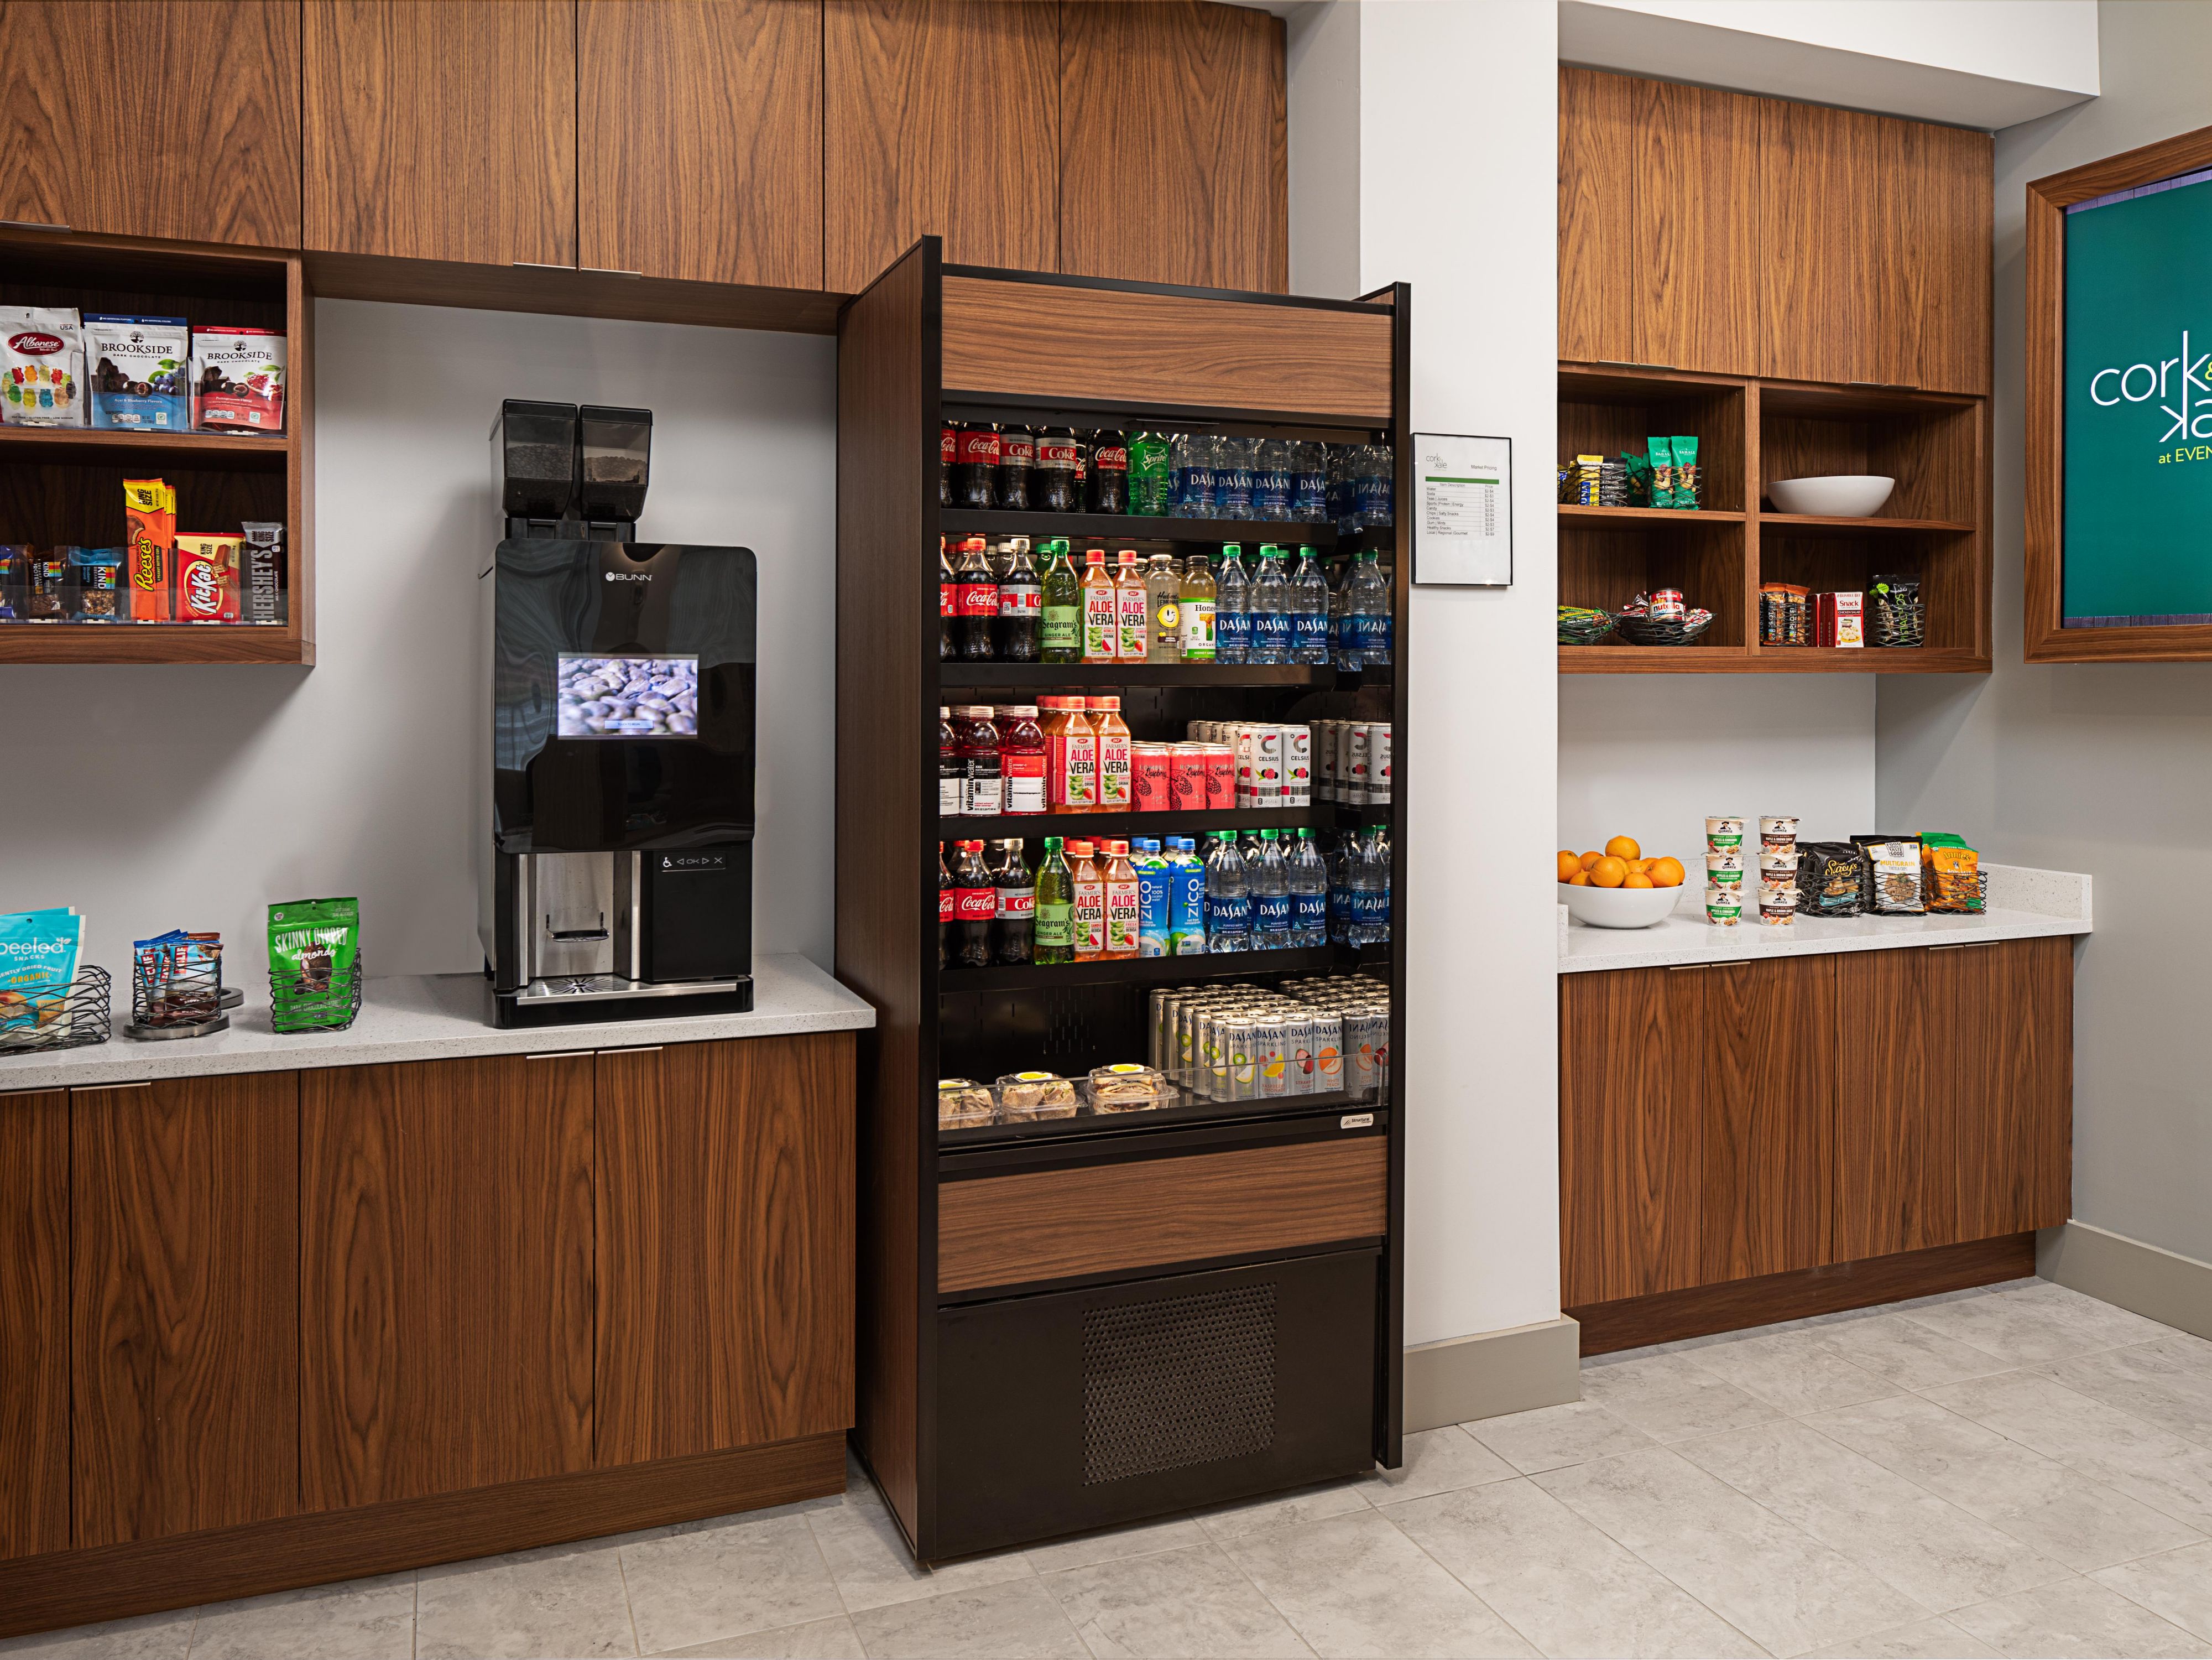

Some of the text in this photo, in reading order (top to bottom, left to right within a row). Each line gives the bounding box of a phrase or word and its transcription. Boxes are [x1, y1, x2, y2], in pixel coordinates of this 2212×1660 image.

[13, 336, 60, 349] Albanese
[101, 343, 173, 354] BROOKSIDE
[207, 351, 272, 360] BROOKSIDE
[2090, 330, 2211, 406] cork
[1009, 444, 1033, 457] Coke
[1049, 447, 1074, 460] Coke
[1143, 453, 1166, 464] Sprite
[2158, 452, 2171, 464] at
[1219, 473, 1253, 490] DASANI
[1256, 473, 1290, 491] DASANI
[265, 531, 274, 542] SIZE
[134, 537, 154, 592] Reese's
[191, 563, 217, 613] KitKat
[251, 550, 275, 619] HERSHEY'S
[1089, 601, 1113, 613] ALOE
[1121, 602, 1144, 614] ALOE
[1042, 619, 1077, 631] Seagram's
[1087, 612, 1114, 626] VERA
[1120, 613, 1145, 626] VERA
[1071, 749, 1093, 761] ALOE
[1105, 749, 1128, 761] ALOE
[1069, 761, 1094, 774] VERA
[1103, 760, 1128, 773] VERA
[966, 759, 974, 811] vitaminwater
[1943, 851, 1971, 861] Annie's
[1825, 860, 1857, 876] Stacy's
[1077, 895, 1100, 908] ALOE
[1112, 895, 1136, 907] ALOE
[1140, 881, 1152, 920] ZICO
[1188, 878, 1199, 918] ZICO
[1076, 907, 1102, 921] VERA
[1110, 907, 1136, 920] VERA
[1035, 918, 1070, 929] Seagram's
[275, 928, 348, 953] SKINNY DIPPED
[291, 944, 336, 960] almonds
[43, 965, 62, 973] FRUIT
[11, 972, 50, 983] ORGANIC
[1258, 1029, 1286, 1041] DASANI
